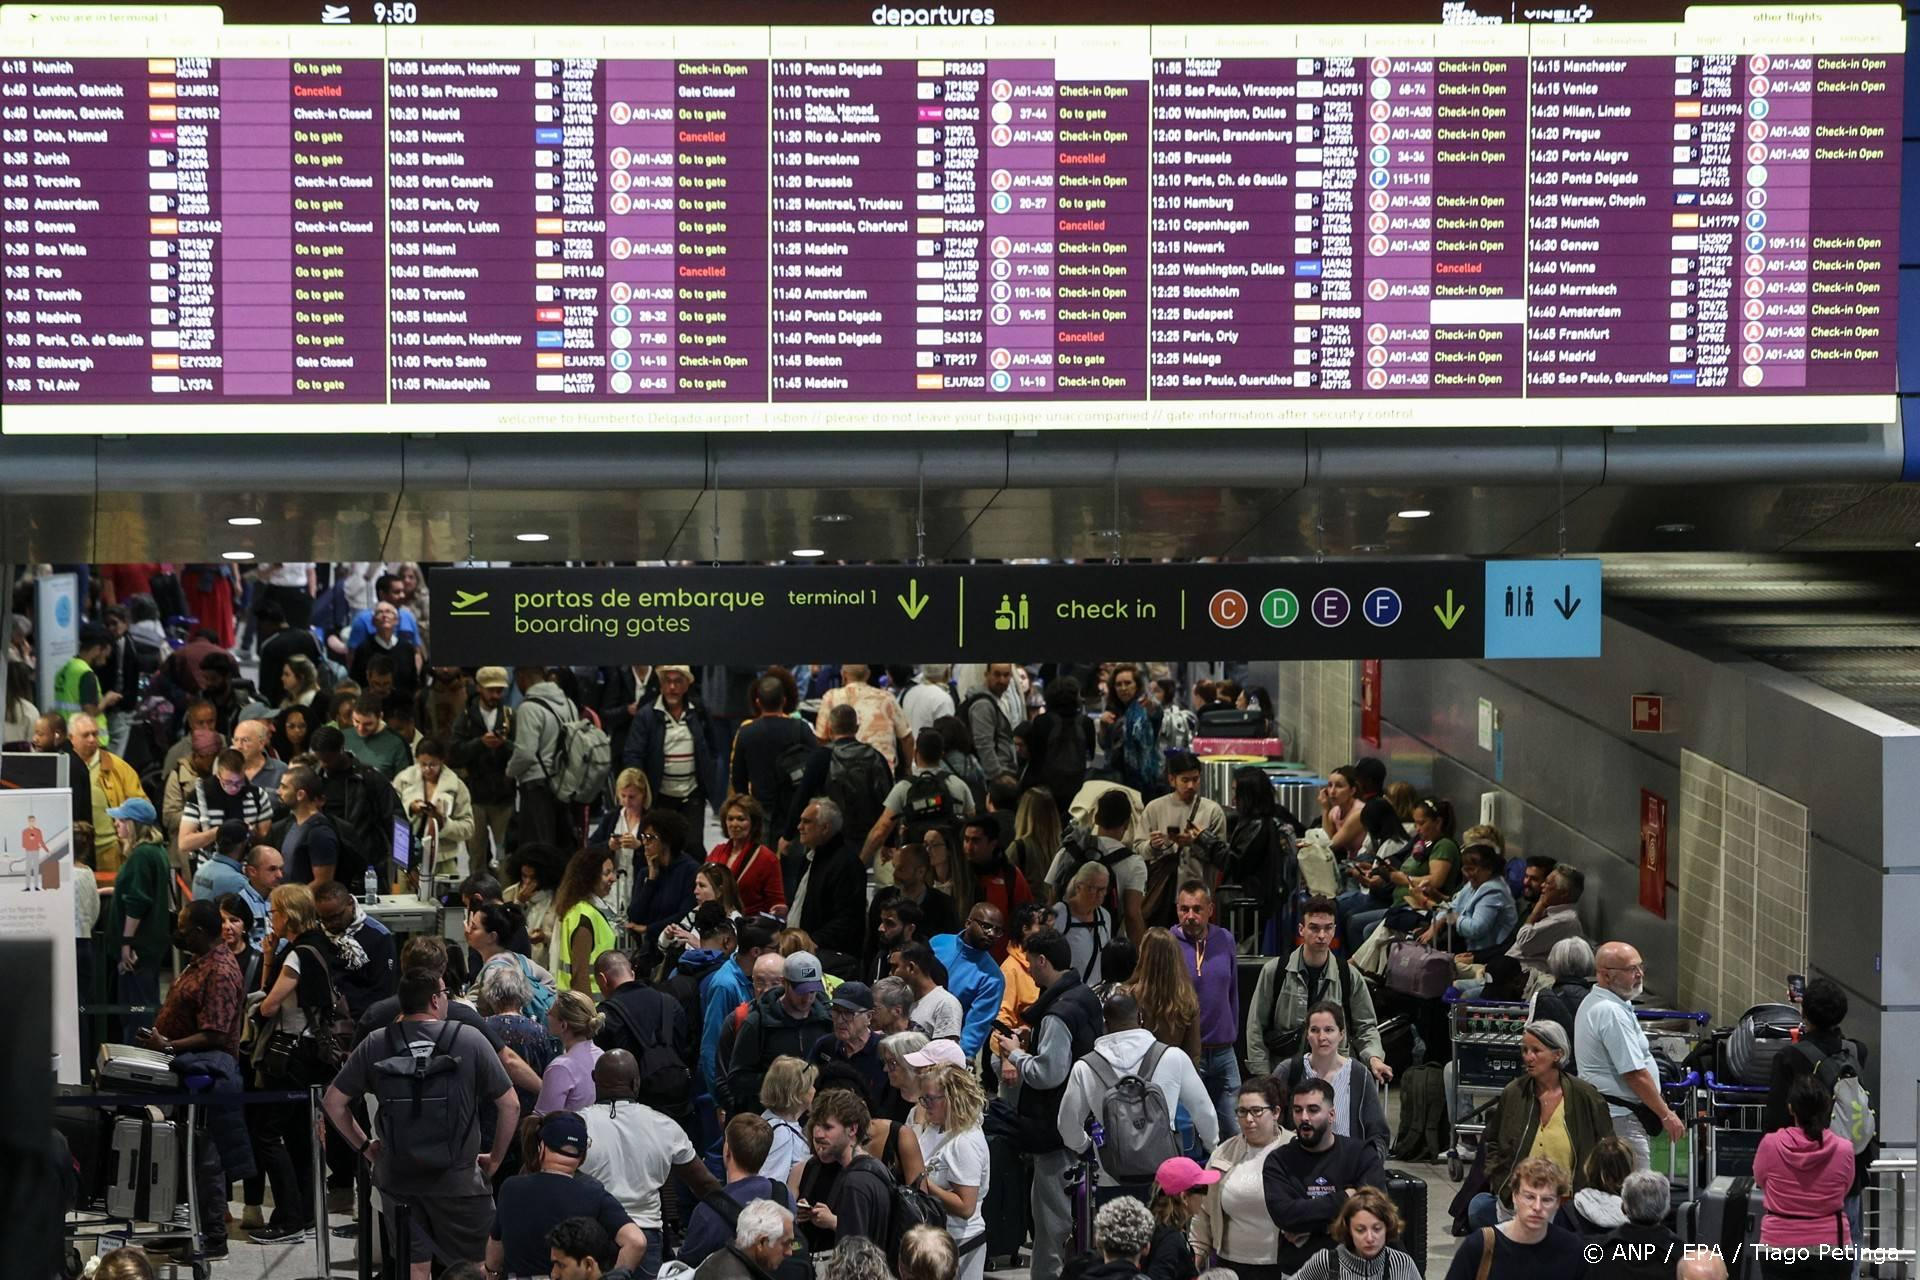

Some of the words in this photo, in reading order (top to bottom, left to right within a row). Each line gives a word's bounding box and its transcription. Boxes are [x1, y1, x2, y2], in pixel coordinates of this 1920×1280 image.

[374, 3, 417, 23] 9:50
[872, 5, 995, 26] departures
[1753, 13, 1782, 22] other
[1787, 12, 1822, 23] flights
[773, 63, 801, 75] 11:10
[805, 63, 836, 75] Ponta
[839, 63, 882, 78] Delgada
[945, 63, 985, 75] FR2623
[1564, 60, 1626, 72] Manchester
[33, 84, 77, 97] London,
[80, 84, 123, 96] Gatwick
[294, 85, 342, 97] Cancelled
[390, 85, 418, 97] 10:10
[422, 85, 442, 97] San
[445, 85, 498, 97] Francisco
[679, 86, 701, 97] Gate
[703, 86, 735, 97] Closed
[294, 108, 337, 119] Check-in
[339, 108, 372, 119] Closed
[390, 108, 419, 120] 10:20
[422, 108, 460, 120] Madrid
[632, 109, 673, 120] A01-A30
[679, 109, 692, 119] Go
[694, 110, 703, 119] to
[706, 110, 726, 122] gate
[1154, 107, 1181, 119] 12:00
[1185, 107, 1249, 121] Washington,
[1253, 107, 1286, 118] Dulles
[1390, 106, 1432, 117] A01-A30
[1438, 107, 1479, 117] Check-in
[1482, 106, 1505, 118] Open
[1563, 105, 1595, 118] Milan,
[1598, 105, 1631, 117] Linate
[1702, 103, 1742, 116] EJU1994
[773, 131, 801, 143] 11:20
[805, 131, 823, 142] Rio
[825, 131, 838, 142] de
[840, 131, 881, 142] Janeiro
[1060, 131, 1101, 141] Check-in
[1104, 131, 1127, 143] Open
[1185, 174, 1214, 187] Paris,
[1218, 174, 1235, 186] Ch.
[1238, 174, 1251, 186] de
[1253, 174, 1287, 185] Gaulle
[805, 198, 856, 211] Montreal,
[859, 198, 902, 209] Trudeau
[1561, 195, 1606, 207] Warsaw,
[1609, 194, 1646, 208] Chopin
[35, 221, 76, 233] Geneva
[295, 221, 338, 232] Check-in
[340, 221, 373, 232] Closed
[423, 221, 466, 234] London,
[468, 221, 499, 232] Luton
[1153, 219, 1180, 231] 12:10
[1184, 219, 1249, 233] Copenhagen
[1561, 217, 1599, 228] Munich
[1700, 216, 1739, 227] LH1779
[1813, 238, 1855, 248] Check-in
[1857, 238, 1881, 249] Open
[391, 266, 419, 278] 10:40
[423, 266, 478, 277] Eindhoven
[679, 266, 726, 277] Cancelled
[1436, 263, 1482, 273] Cancelled
[423, 288, 465, 300] Toronto
[564, 288, 597, 300] TP257
[1152, 308, 1180, 320] 12:25
[1184, 308, 1233, 321] Budapest
[391, 356, 420, 367] 11:00
[424, 356, 453, 367] Porto
[455, 356, 486, 367] Santo
[773, 355, 801, 366] 11:45
[805, 355, 842, 366] Boston
[944, 354, 977, 365] TP217
[1013, 354, 1052, 364] A01-A30
[1559, 350, 1595, 361] Madrid
[7, 357, 30, 368] 9:50
[37, 357, 93, 371] Edinburgh
[296, 357, 319, 367] Gate
[320, 357, 353, 367] Closed
[680, 356, 721, 366] Check-in
[724, 356, 747, 368] Open
[7, 379, 31, 391] 9:55
[37, 379, 55, 391] Tel
[56, 379, 80, 391] Aviv
[180, 378, 213, 391] LY374
[297, 379, 310, 389] Go
[312, 381, 321, 389] to
[323, 381, 344, 392] gate
[944, 377, 984, 387] EJU7623
[1152, 375, 1179, 386] 12:30
[1183, 375, 1202, 385] Sao
[1205, 375, 1236, 386] Paulo,
[1239, 375, 1292, 385] Guarulhos
[515, 590, 593, 612] portas
[601, 589, 630, 607] de
[639, 589, 764, 611] embarque
[788, 590, 864, 605] terminal
[869, 590, 876, 605] 1
[1057, 600, 1128, 619] check
[1136, 599, 1156, 618] in
[1220, 598, 1237, 620] C
[1271, 597, 1288, 620] D
[1324, 597, 1338, 619] E
[1375, 596, 1390, 618] F
[515, 614, 617, 637] boarding
[627, 616, 690, 637] gates
